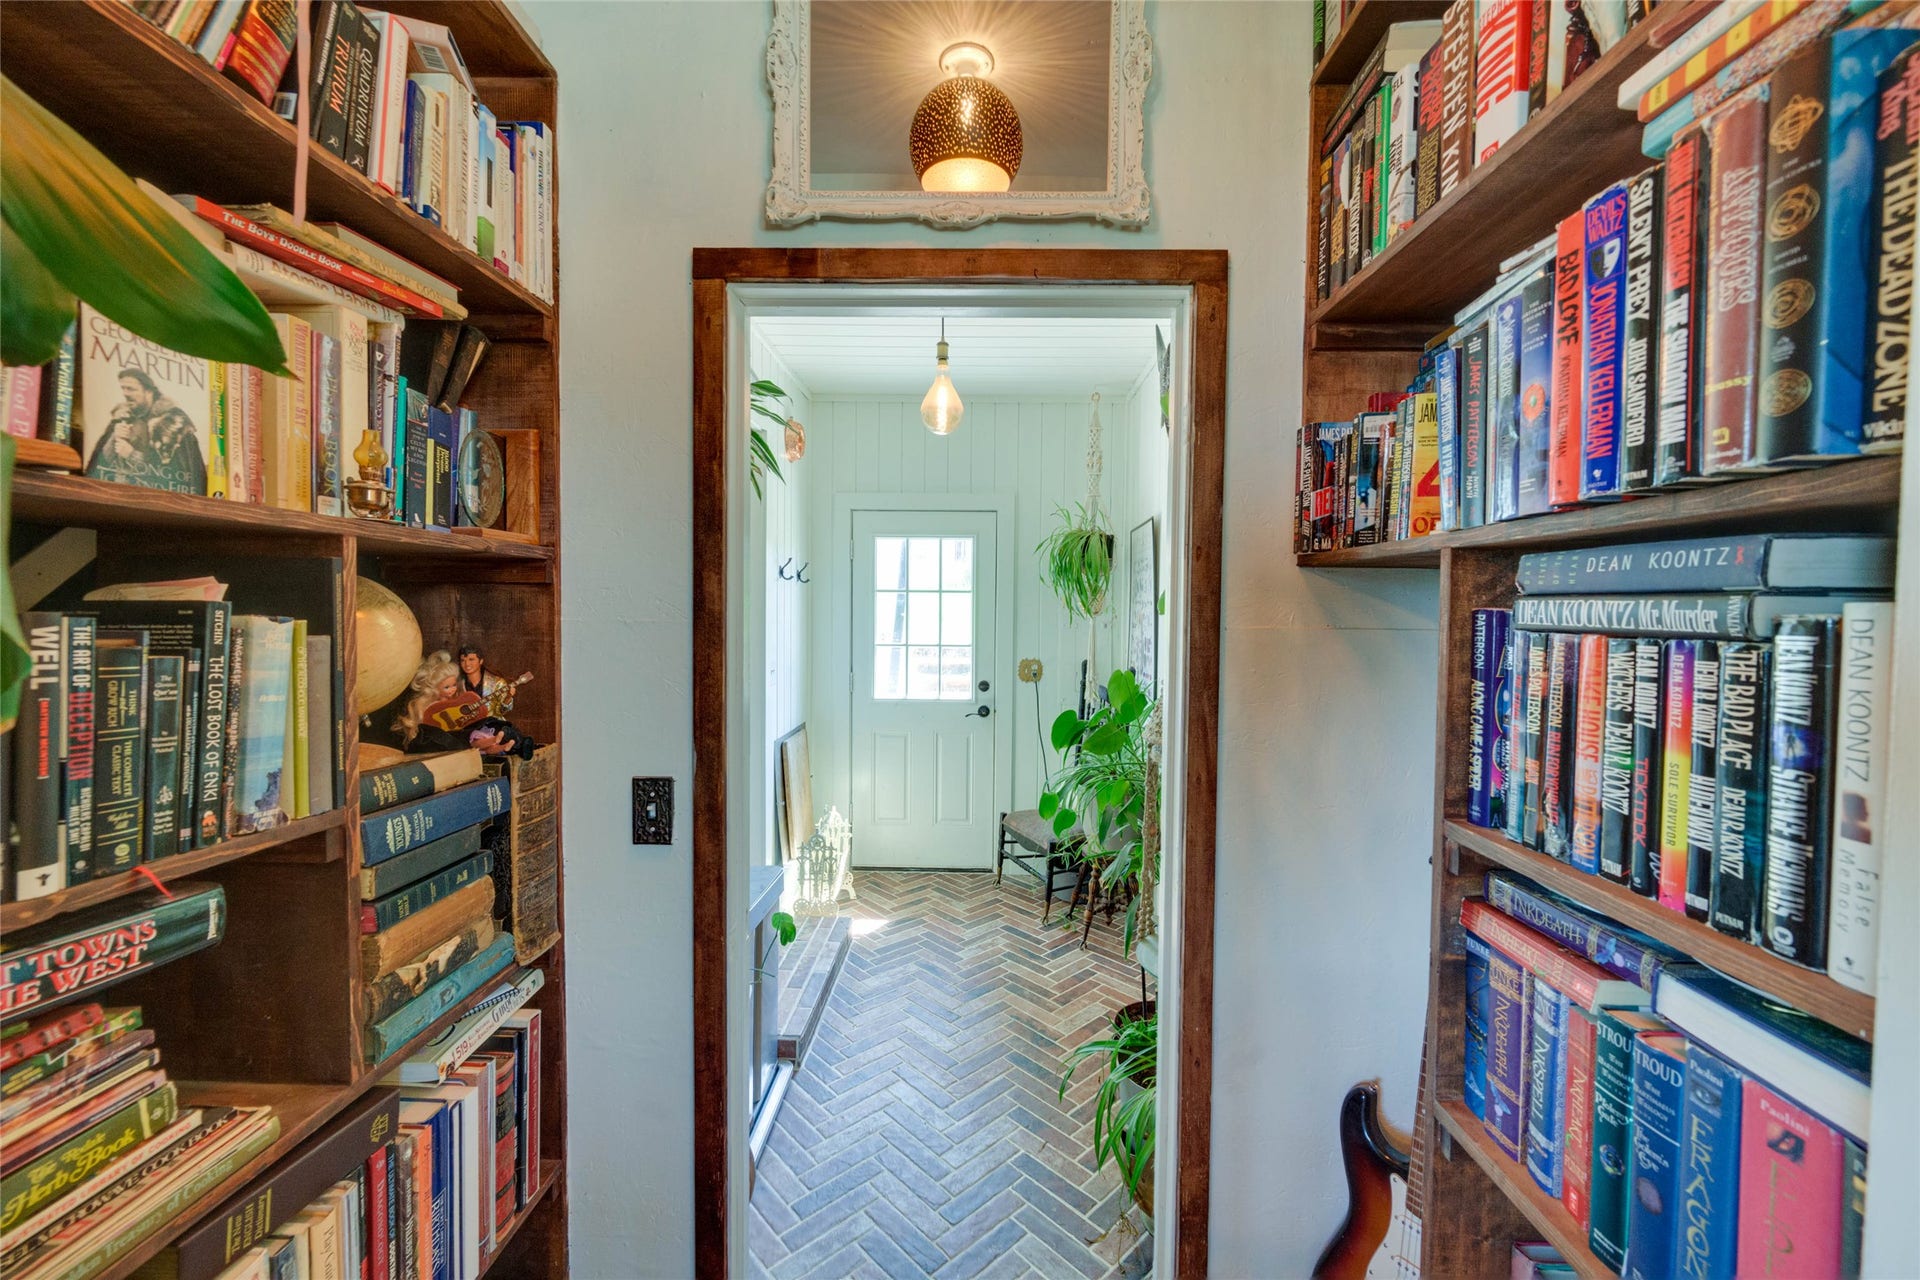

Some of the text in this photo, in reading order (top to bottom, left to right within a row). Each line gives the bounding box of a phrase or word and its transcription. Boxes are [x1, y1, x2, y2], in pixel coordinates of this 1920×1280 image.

[329, 35, 350, 114] TRIVIUM
[1475, 3, 1517, 120] KING
[355, 48, 373, 147] QUADRIVIUM
[1442, 4, 1463, 197] STEPHEN KIN
[1876, 79, 1904, 142] King
[1424, 128, 1439, 209] NIGHTMARES
[222, 211, 343, 272] THE DOODLE BOOK
[1588, 215, 1623, 244] WALTZ
[1718, 164, 1759, 311] ANTIQUES
[1626, 177, 1654, 448] SILENT PREY JOHN SANDFORD
[1872, 157, 1919, 412] THE DEAD ZONE
[90, 335, 205, 391] MARTIN
[1468, 356, 1483, 394] JAMES
[1499, 352, 1514, 398] ROBERTS
[1556, 248, 1580, 458] BAD LOVE JONATHAN KELLERMAN
[1586, 281, 1617, 460] JONATHAN KELLERMAN
[1660, 292, 1688, 447] THE SHADOW MAN
[1317, 428, 1342, 441] JAMES
[1439, 376, 1453, 442] JAMES PATTERSON
[1466, 401, 1481, 467] PATTERSON
[324, 439, 338, 494] BOOK
[1302, 445, 1311, 508] JAMES PATTERSON
[1389, 441, 1403, 515] JAMES PATTERSON
[1402, 448, 1412, 482] PATTERSON
[1587, 554, 1632, 573] DEAN
[1648, 546, 1729, 570] KOONTZ
[1518, 599, 1718, 633] DEAN KOONTZ Mr. Murder
[1728, 596, 1743, 638] PUTNAM
[30, 625, 60, 690] WELL
[1552, 641, 1565, 676] JAMES
[1607, 651, 1635, 712] WATCHERS
[1634, 645, 1659, 729] DEAN KOONTZ
[1774, 635, 1819, 727] DEAN KOONTZ
[66, 626, 93, 781] THE ART OF DECEPTION
[107, 680, 118, 727] GROW RICH
[127, 689, 137, 716] THINK
[202, 609, 224, 802] SITCHIN THE LOST BOOK OF ENKI
[1468, 613, 1486, 792] PATTERSON ALONG CAME SPIDER
[1526, 646, 1544, 735] JAMES PATTERSON
[1549, 677, 1563, 728] PATTERSON
[1844, 618, 1876, 783] DEAN KOONTZ
[1548, 730, 1561, 757] RUN
[1577, 709, 1601, 763] HOUSE
[1604, 721, 1633, 752] DEAN
[1665, 654, 1685, 847] DEAN KOONTZ SOLE SURVIVOR
[1687, 660, 1719, 852] DEAN KOONTZ HIDEAWAY
[1719, 649, 1757, 881] THE BAD PLACE DEAN KOONTZ
[110, 745, 122, 795] CLASSIC TEXT
[122, 740, 132, 797] THE COMPLETE
[1602, 767, 1631, 816] KOONTZ
[1770, 765, 1815, 842] STRANGE
[1512, 895, 1585, 945] INKDEATH
[1836, 849, 1855, 934] Memory
[1853, 866, 1880, 928] False
[34, 919, 157, 980] TOWNS
[51, 943, 149, 992] WEST
[1493, 995, 1511, 1078] INKDEATH
[1596, 1020, 1633, 1053] STROU
[1530, 1033, 1551, 1120] INKSPELL
[1689, 1058, 1725, 1089] Paolini
[1568, 1064, 1588, 1149] INKHEART
[1760, 1100, 1810, 1137] Paolini
[69, 1129, 136, 1184] Book
[79, 1121, 192, 1201] LIBRARY OF COOKING
[178, 1160, 235, 1202] Cooking
[387, 1168, 396, 1204] ULTIMATE
[376, 1179, 386, 1265] DRAGONOLOGY
[387, 1206, 396, 1227] BOOK
